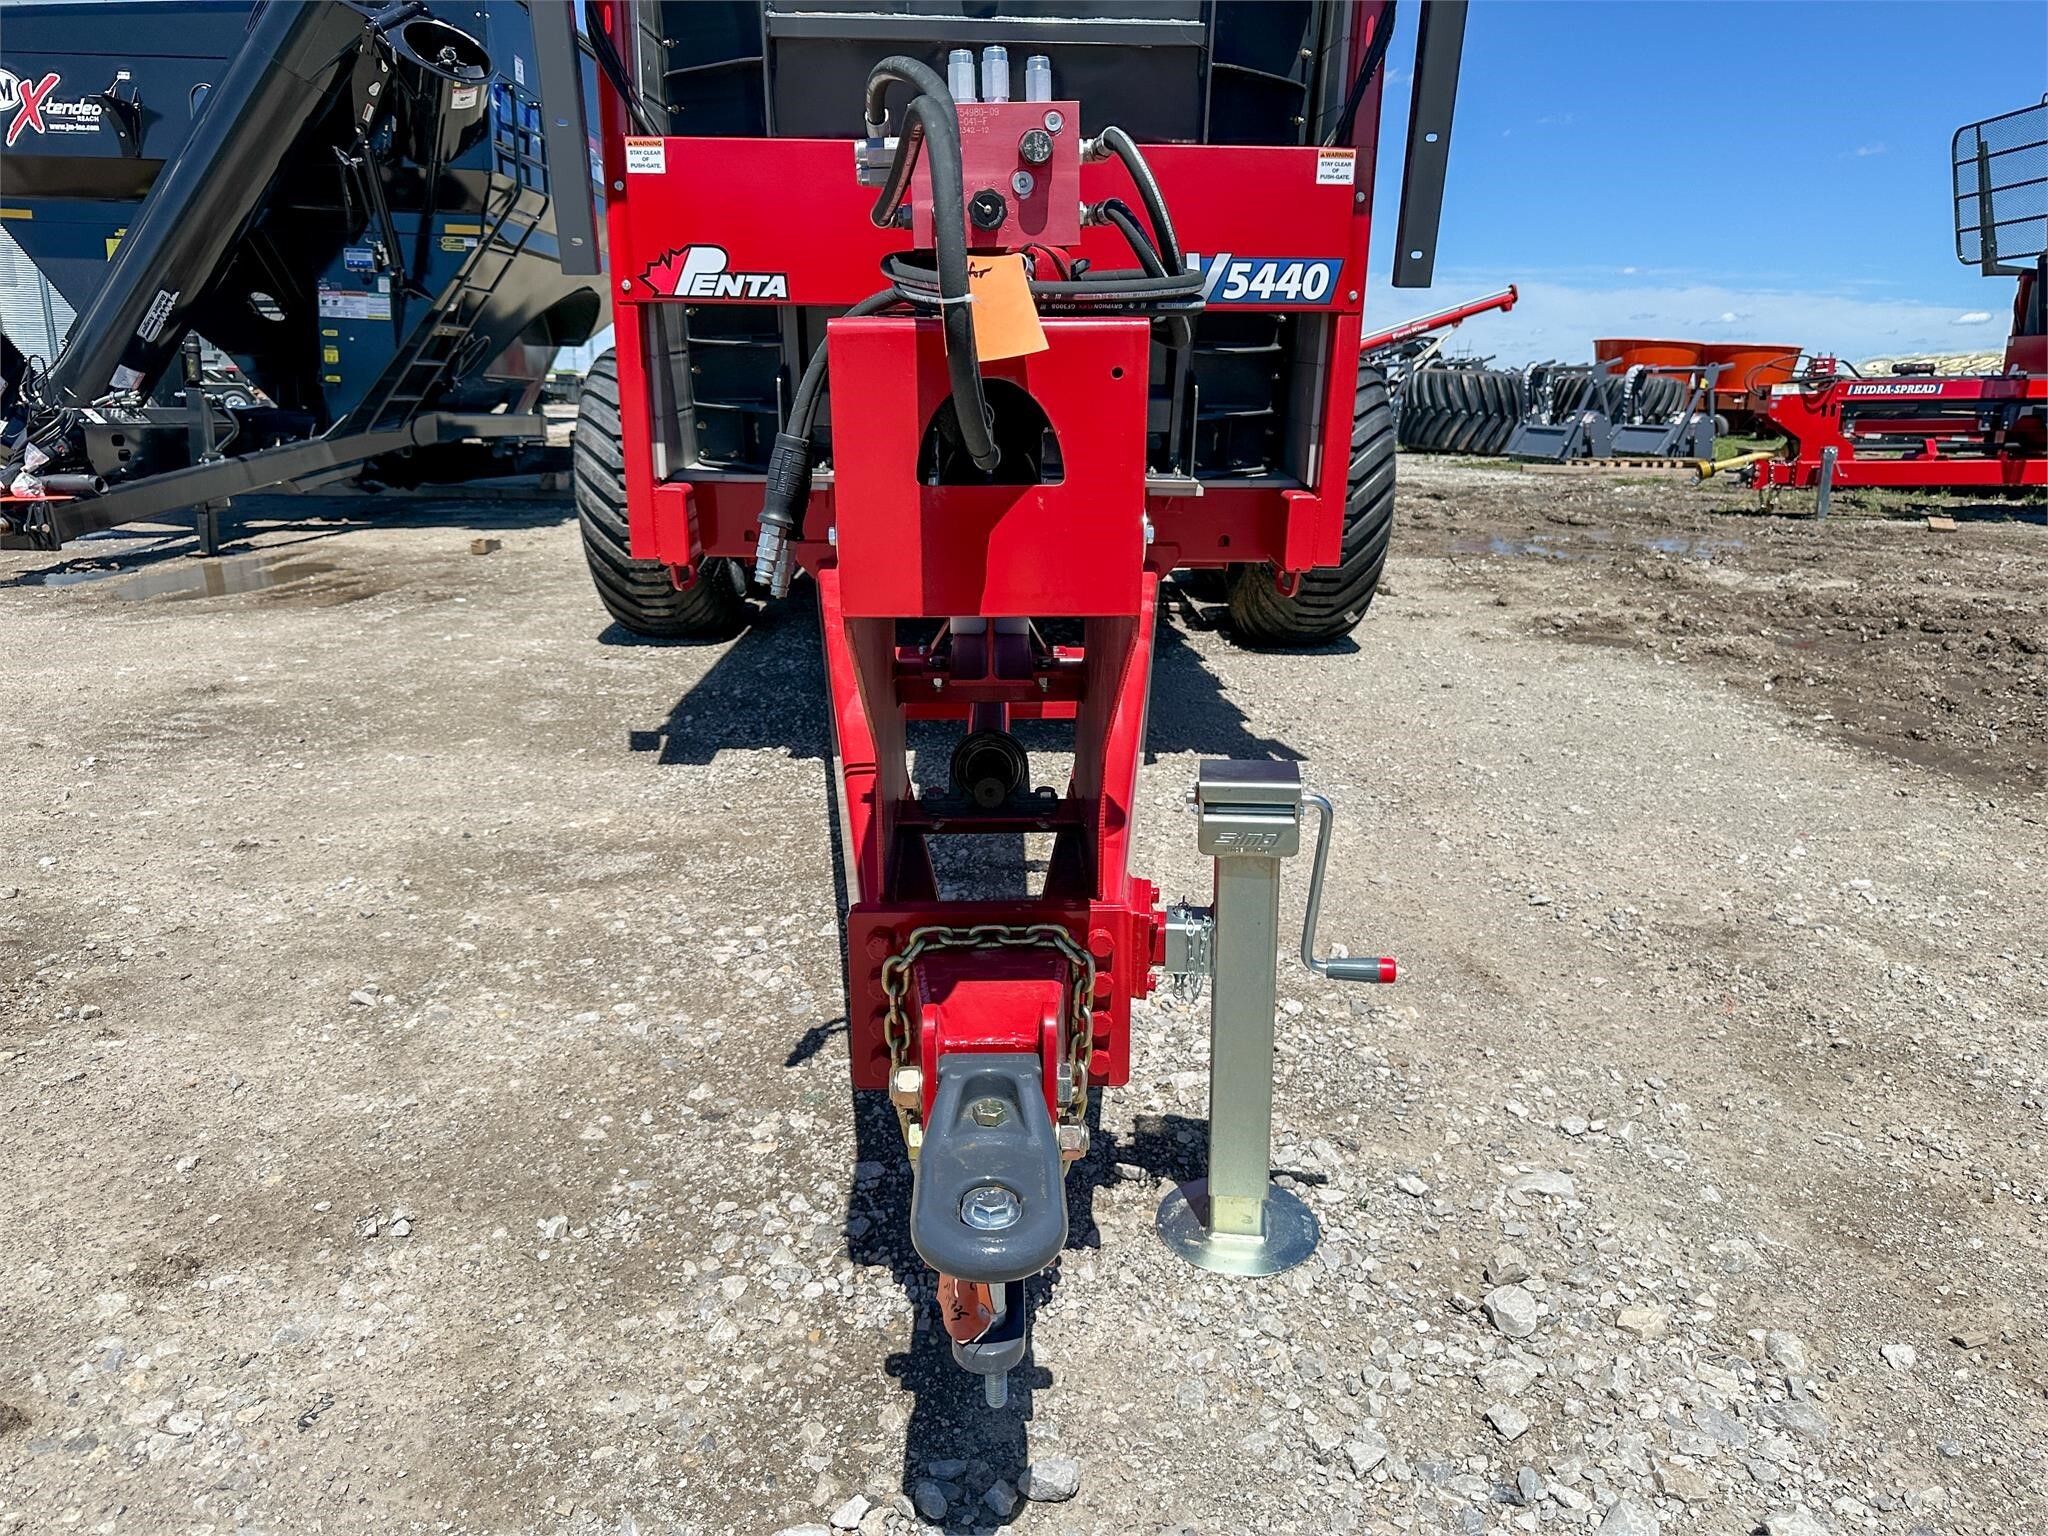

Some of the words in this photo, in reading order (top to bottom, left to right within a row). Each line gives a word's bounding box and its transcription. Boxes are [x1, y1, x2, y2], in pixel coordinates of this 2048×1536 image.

[956, 107, 1000, 118] 54980-09
[1326, 151, 1354, 159] WARNING
[1853, 384, 1937, 396] HYDRA-SPREAD
